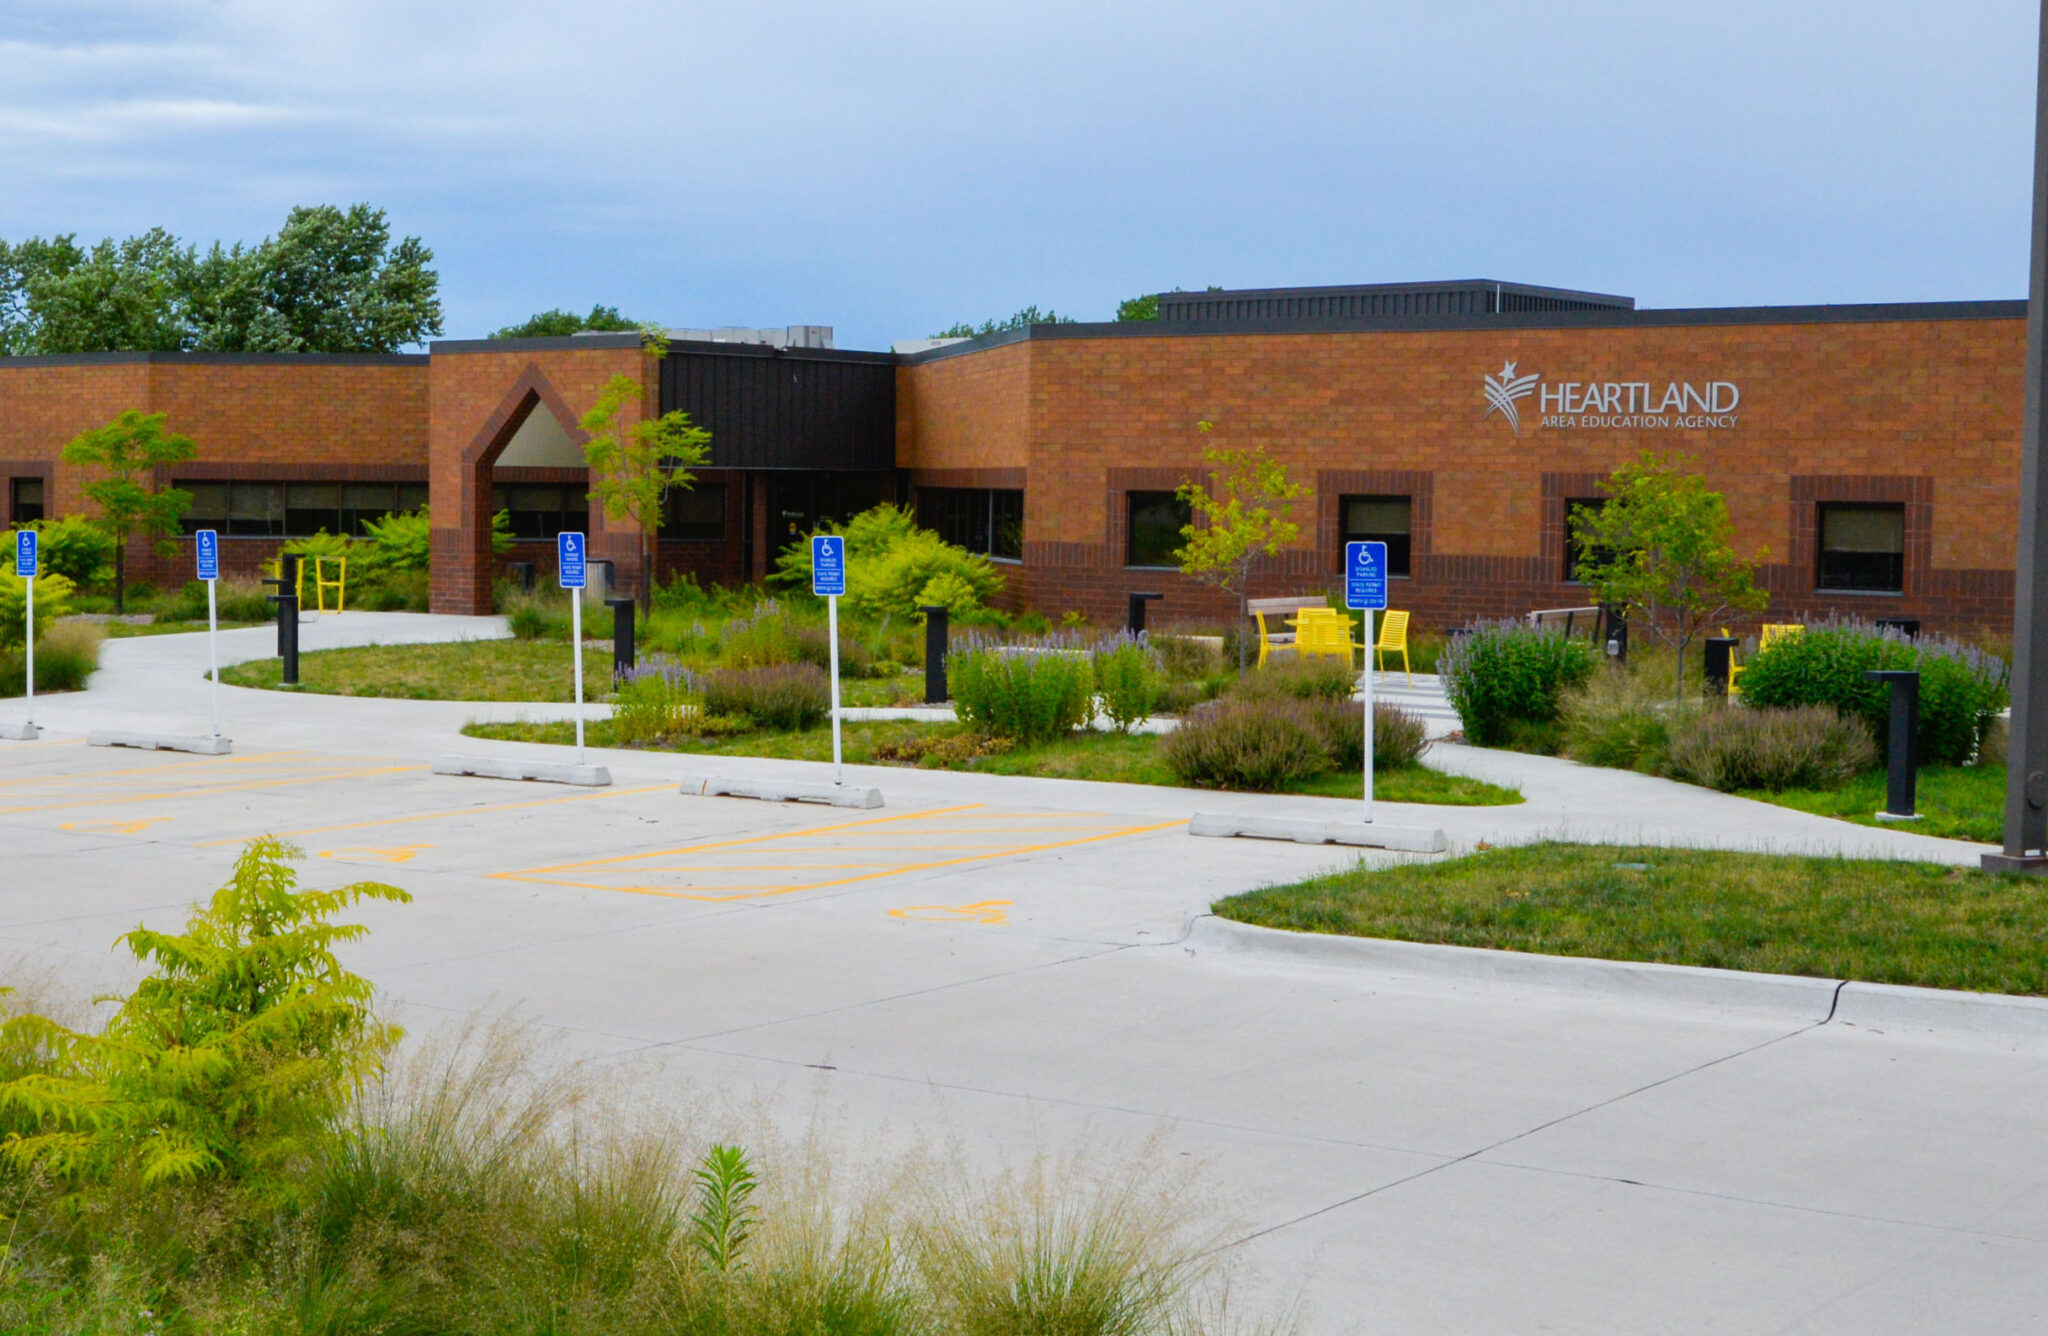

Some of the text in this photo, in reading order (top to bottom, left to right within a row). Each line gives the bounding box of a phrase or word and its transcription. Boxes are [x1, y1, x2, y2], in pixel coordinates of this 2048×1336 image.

[1540, 381, 1740, 414] HEARTLAND
[1541, 415, 1738, 428] AREA EDUCATION AGENCY
